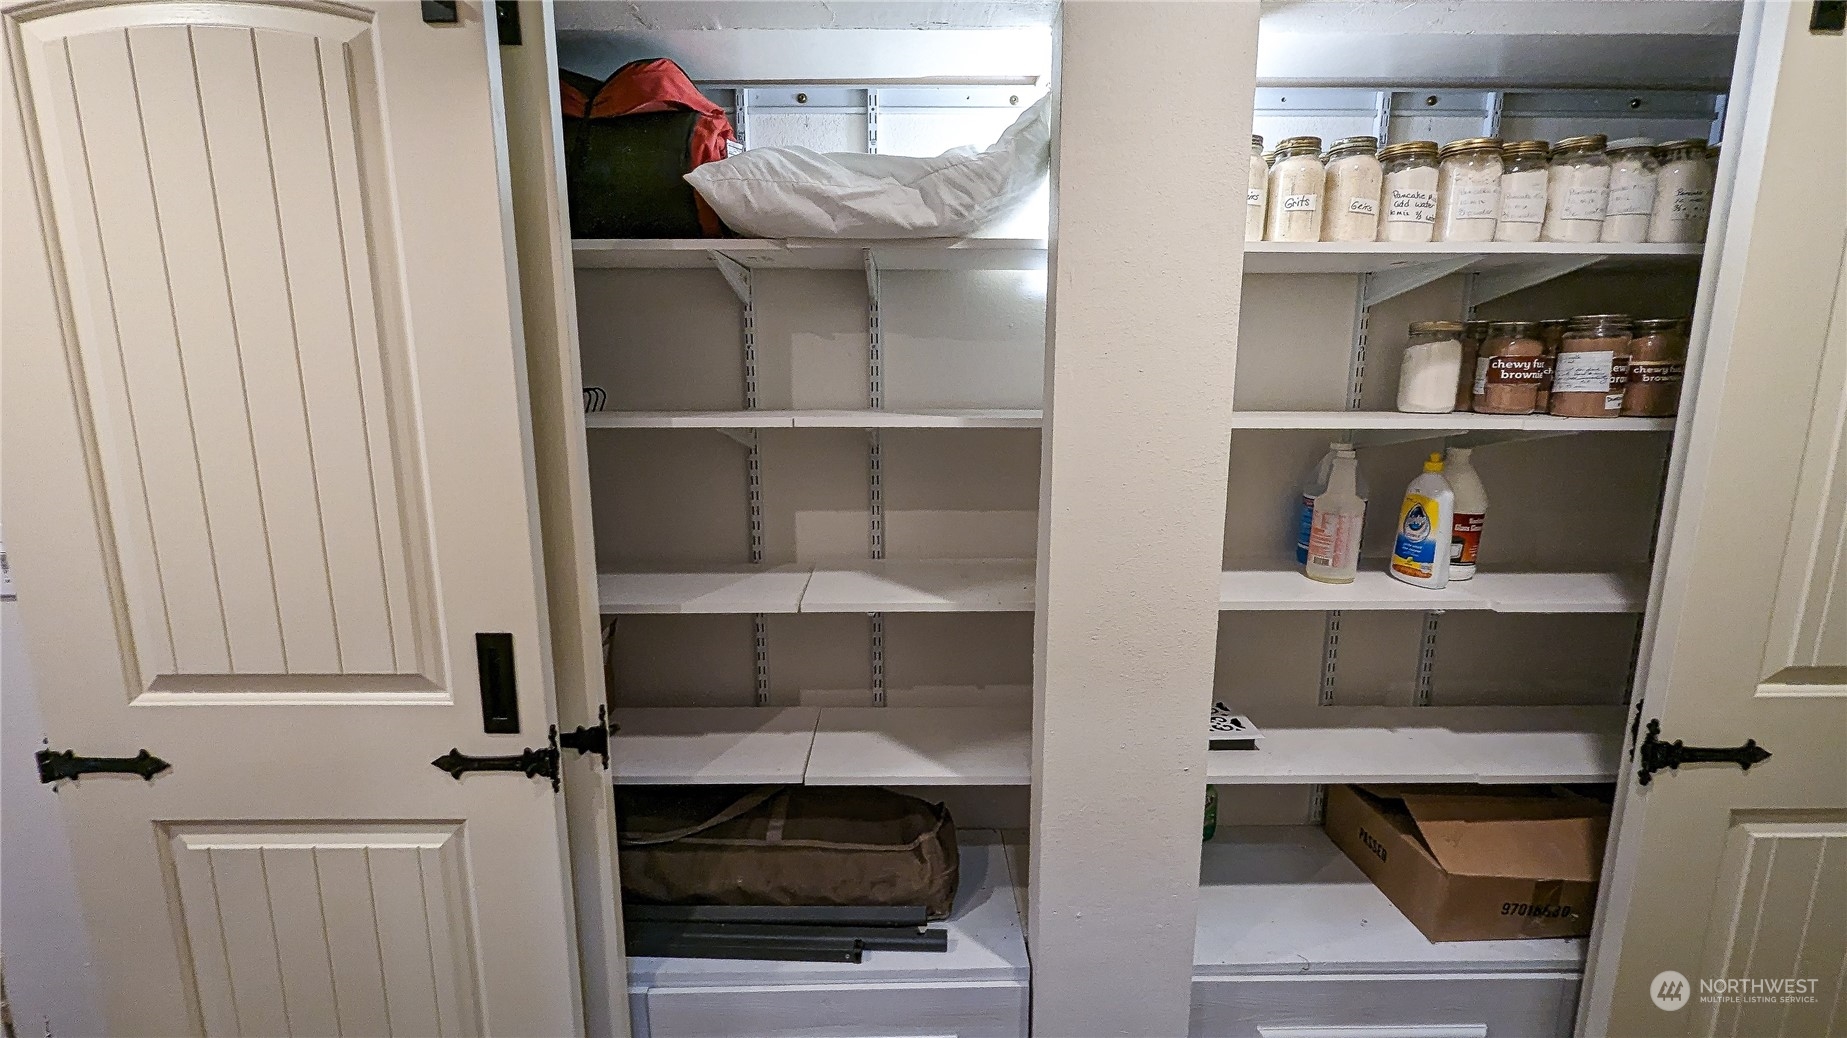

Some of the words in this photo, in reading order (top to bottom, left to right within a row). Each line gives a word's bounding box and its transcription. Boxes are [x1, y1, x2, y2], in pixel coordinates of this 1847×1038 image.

[1392, 189, 1425, 200] Pancake
[1284, 195, 1310, 209] Grits
[1492, 360, 1531, 370] chewy
[1633, 366, 1668, 375] chewy
